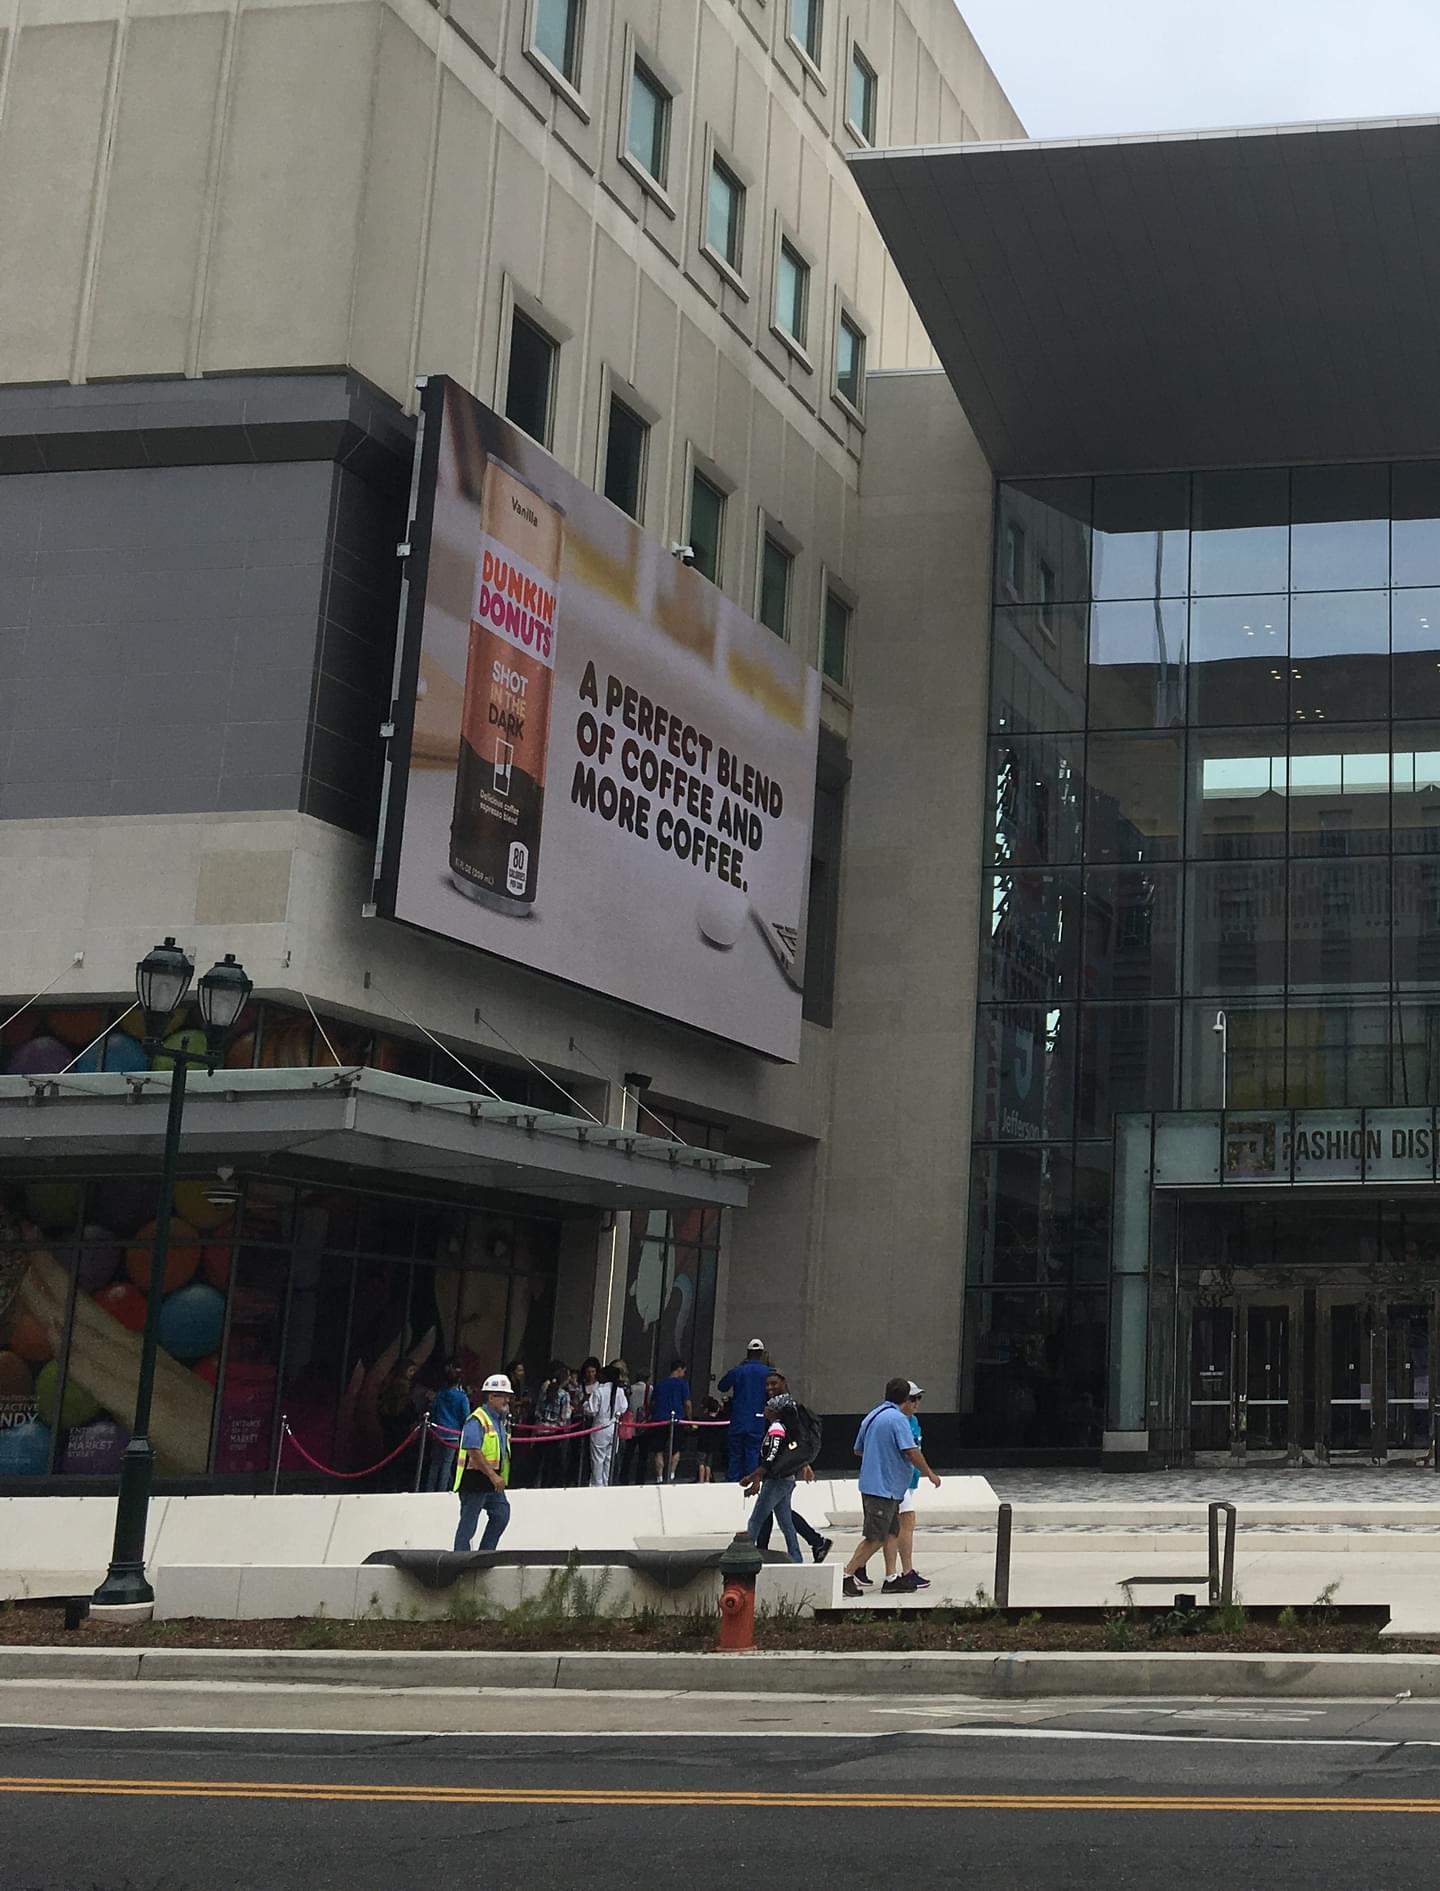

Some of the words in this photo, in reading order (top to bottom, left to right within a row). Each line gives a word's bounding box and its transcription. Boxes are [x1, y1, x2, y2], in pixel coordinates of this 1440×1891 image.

[511, 496, 538, 528] Vanilla
[482, 550, 557, 625] DUNKIN'
[480, 584, 552, 658] DONUTS
[492, 660, 528, 697] SHOT
[488, 703, 525, 741] DARK
[505, 690, 527, 720] THE
[579, 660, 598, 708] A
[606, 674, 713, 775] PERFECT
[717, 747, 783, 818] BLEND
[577, 711, 615, 765] OF
[621, 738, 714, 825] COFFEE
[717, 796, 763, 851] AND
[571, 761, 651, 840] MORE
[656, 808, 748, 892] COFFEE.
[513, 847, 524, 869] 80
[1282, 1129, 1381, 1161] FASHION
[0, 1412, 39, 1427] NDY
[67, 1440, 114, 1450] MARKET
